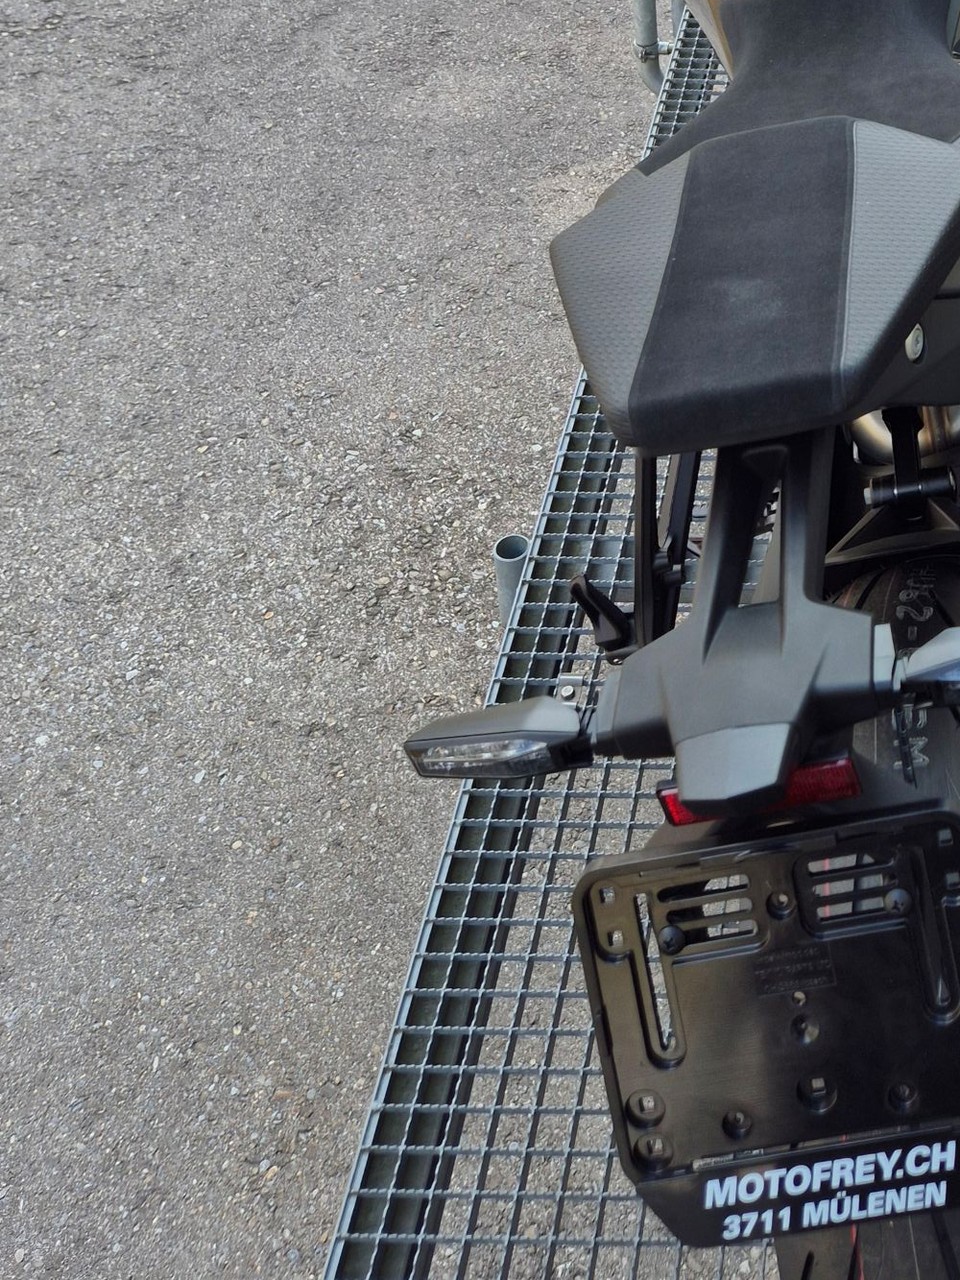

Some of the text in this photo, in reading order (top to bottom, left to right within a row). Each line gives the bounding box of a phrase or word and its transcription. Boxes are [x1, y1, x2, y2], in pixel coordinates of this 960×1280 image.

[704, 1140, 957, 1210] MOTOFREY.CH
[721, 1180, 948, 1241] 3711 MÜLENEN
